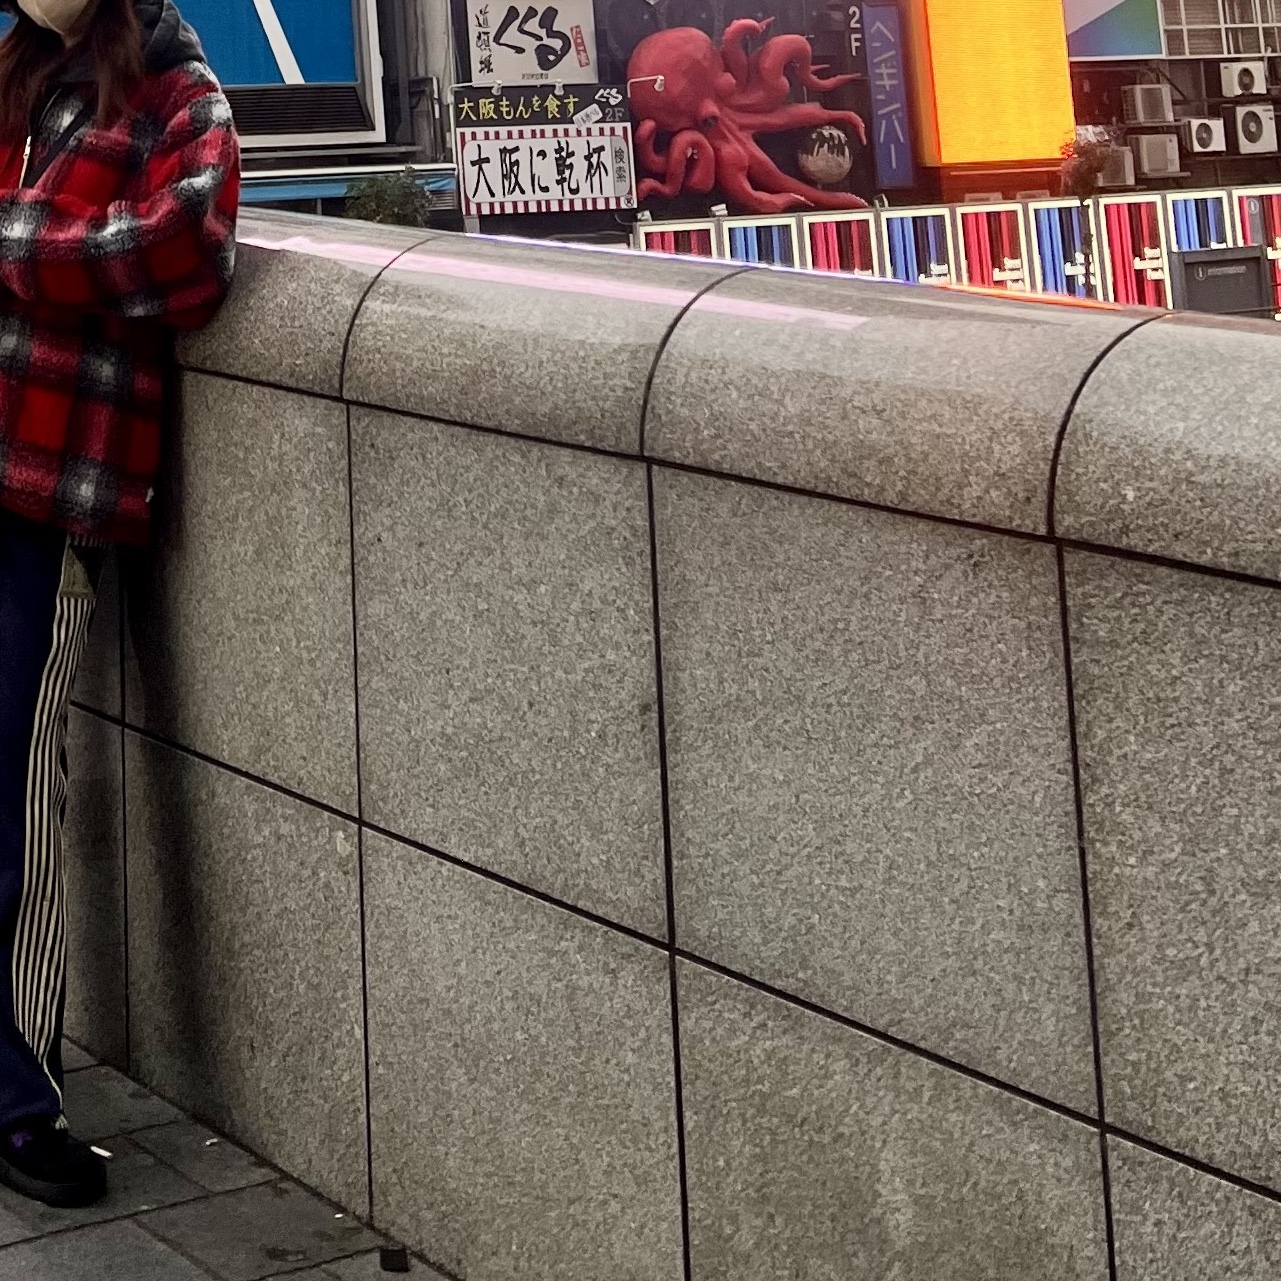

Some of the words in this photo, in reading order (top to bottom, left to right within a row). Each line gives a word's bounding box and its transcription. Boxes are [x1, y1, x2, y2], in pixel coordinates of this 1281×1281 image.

[493, 5, 572, 71] くくる
[848, 5, 862, 57] 2F
[458, 93, 580, 121] 大阪もんを食す
[604, 107, 625, 122] 2F
[469, 139, 609, 200] 大阪に乾杯
